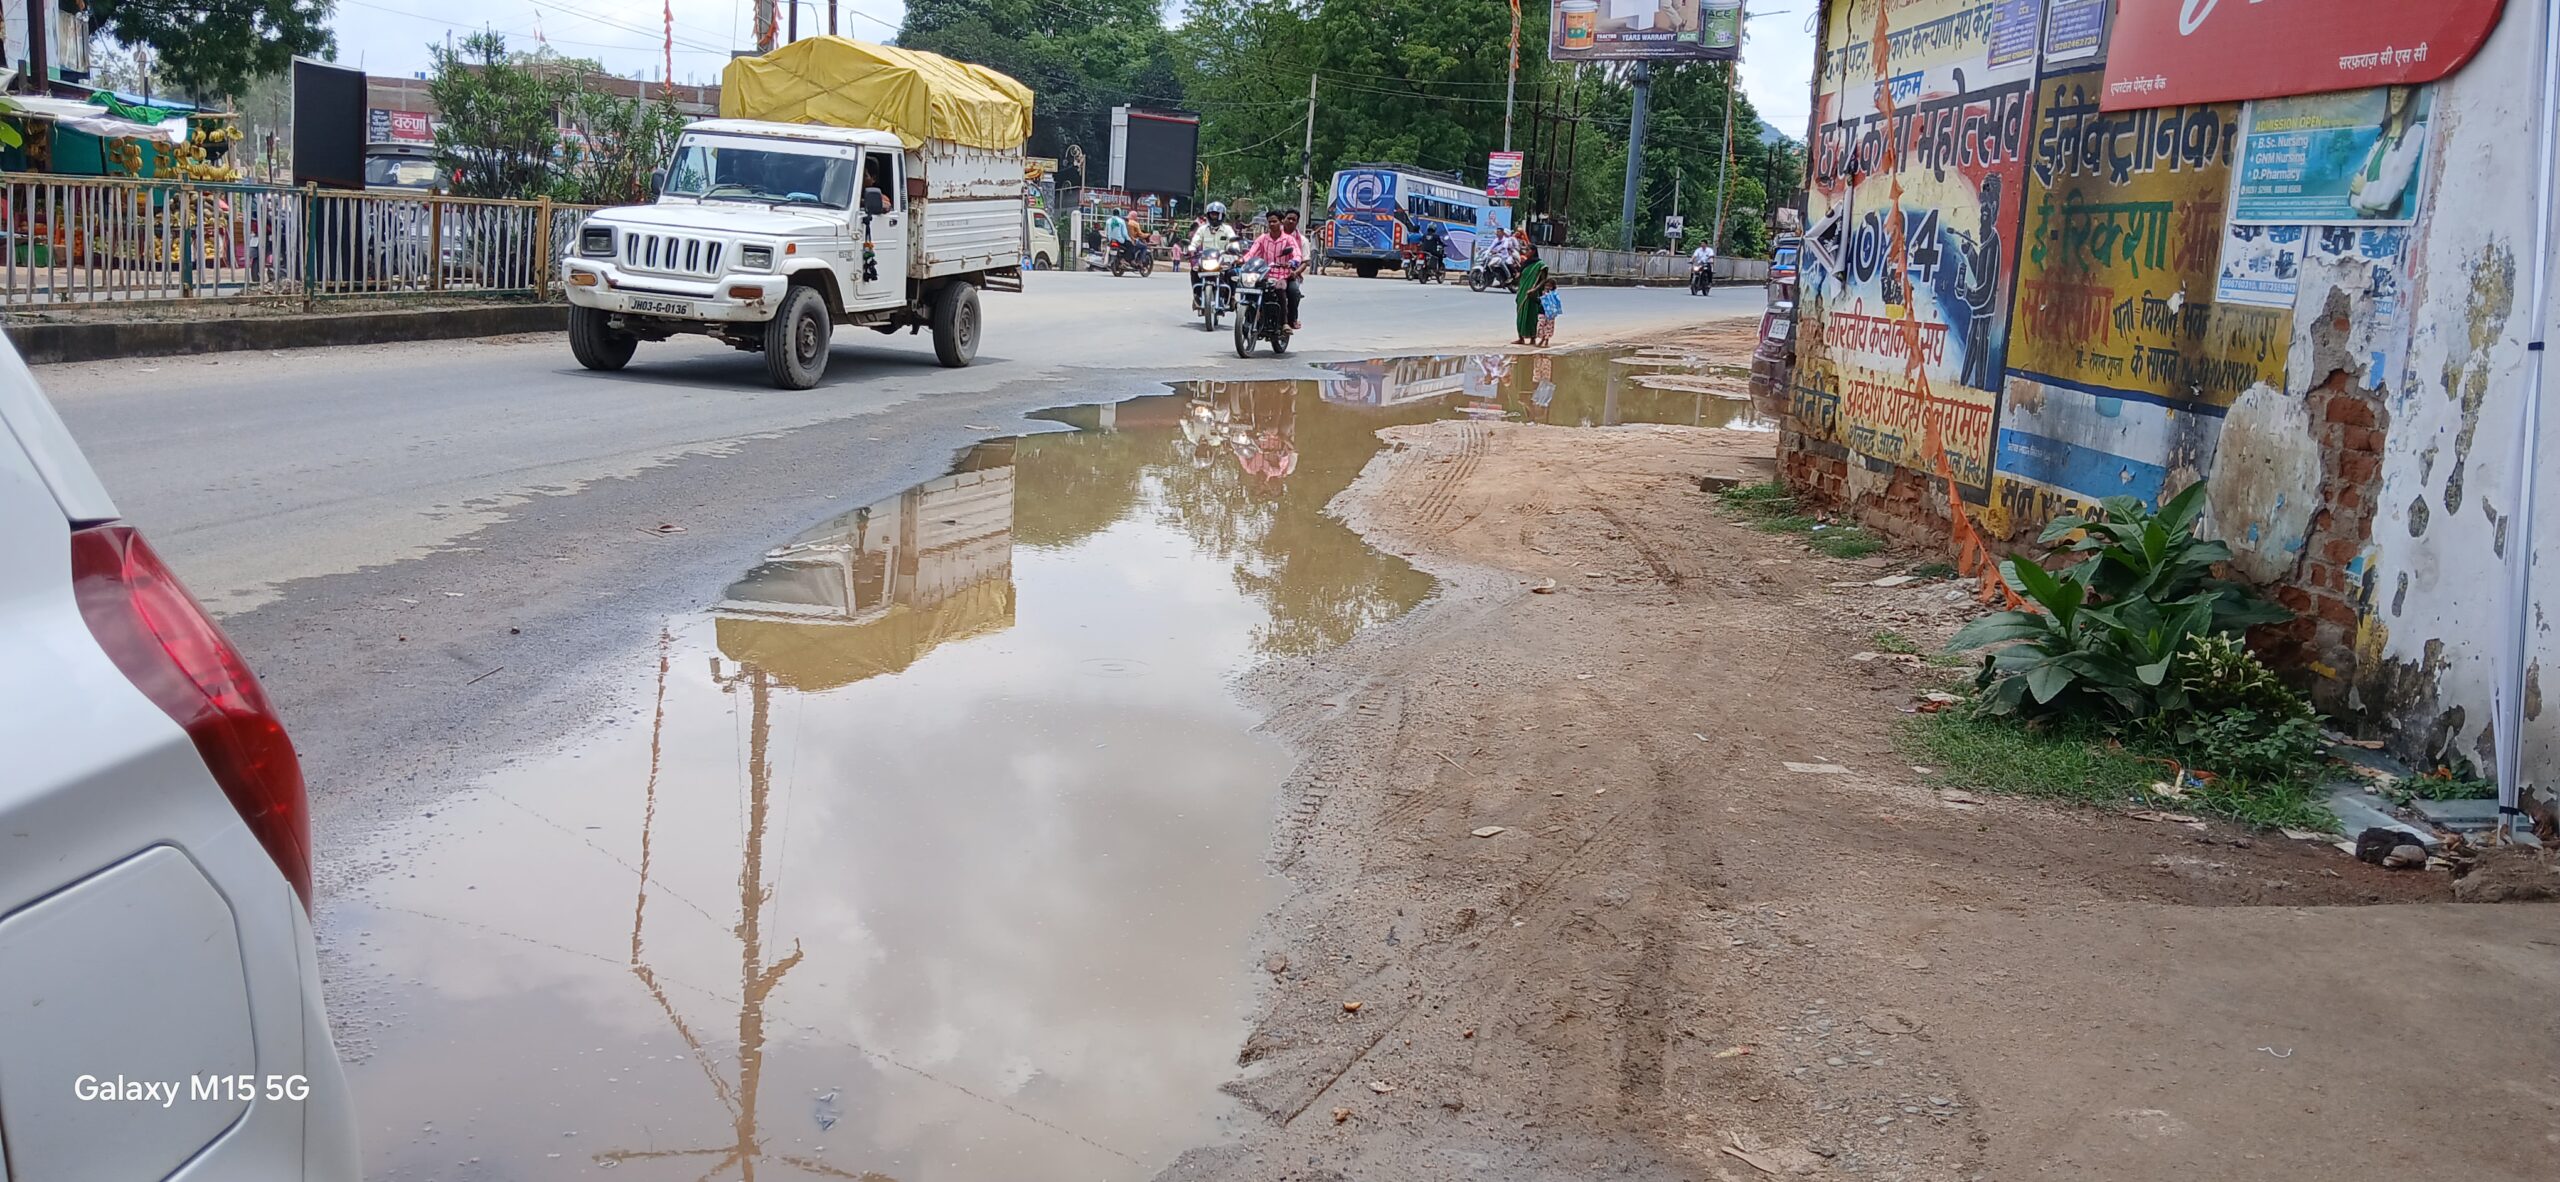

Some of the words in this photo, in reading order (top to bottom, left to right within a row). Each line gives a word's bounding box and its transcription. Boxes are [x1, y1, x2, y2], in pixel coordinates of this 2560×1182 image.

[1622, 33, 1640, 41] YEARS
[1679, 33, 1696, 41] ACE
[2380, 45, 2394, 65] सी
[2395, 49, 2412, 67] एस
[2414, 42, 2428, 62] सी
[2255, 117, 2299, 132] ADMISSION
[2300, 115, 2322, 128] OPEN
[2278, 136, 2308, 150] Nursing
[2255, 153, 2274, 165] GNM
[2275, 152, 2305, 165] Nursing
[2252, 168, 2301, 182] D.Pharmacy
[631, 300, 687, 315] JH03-G-0136
